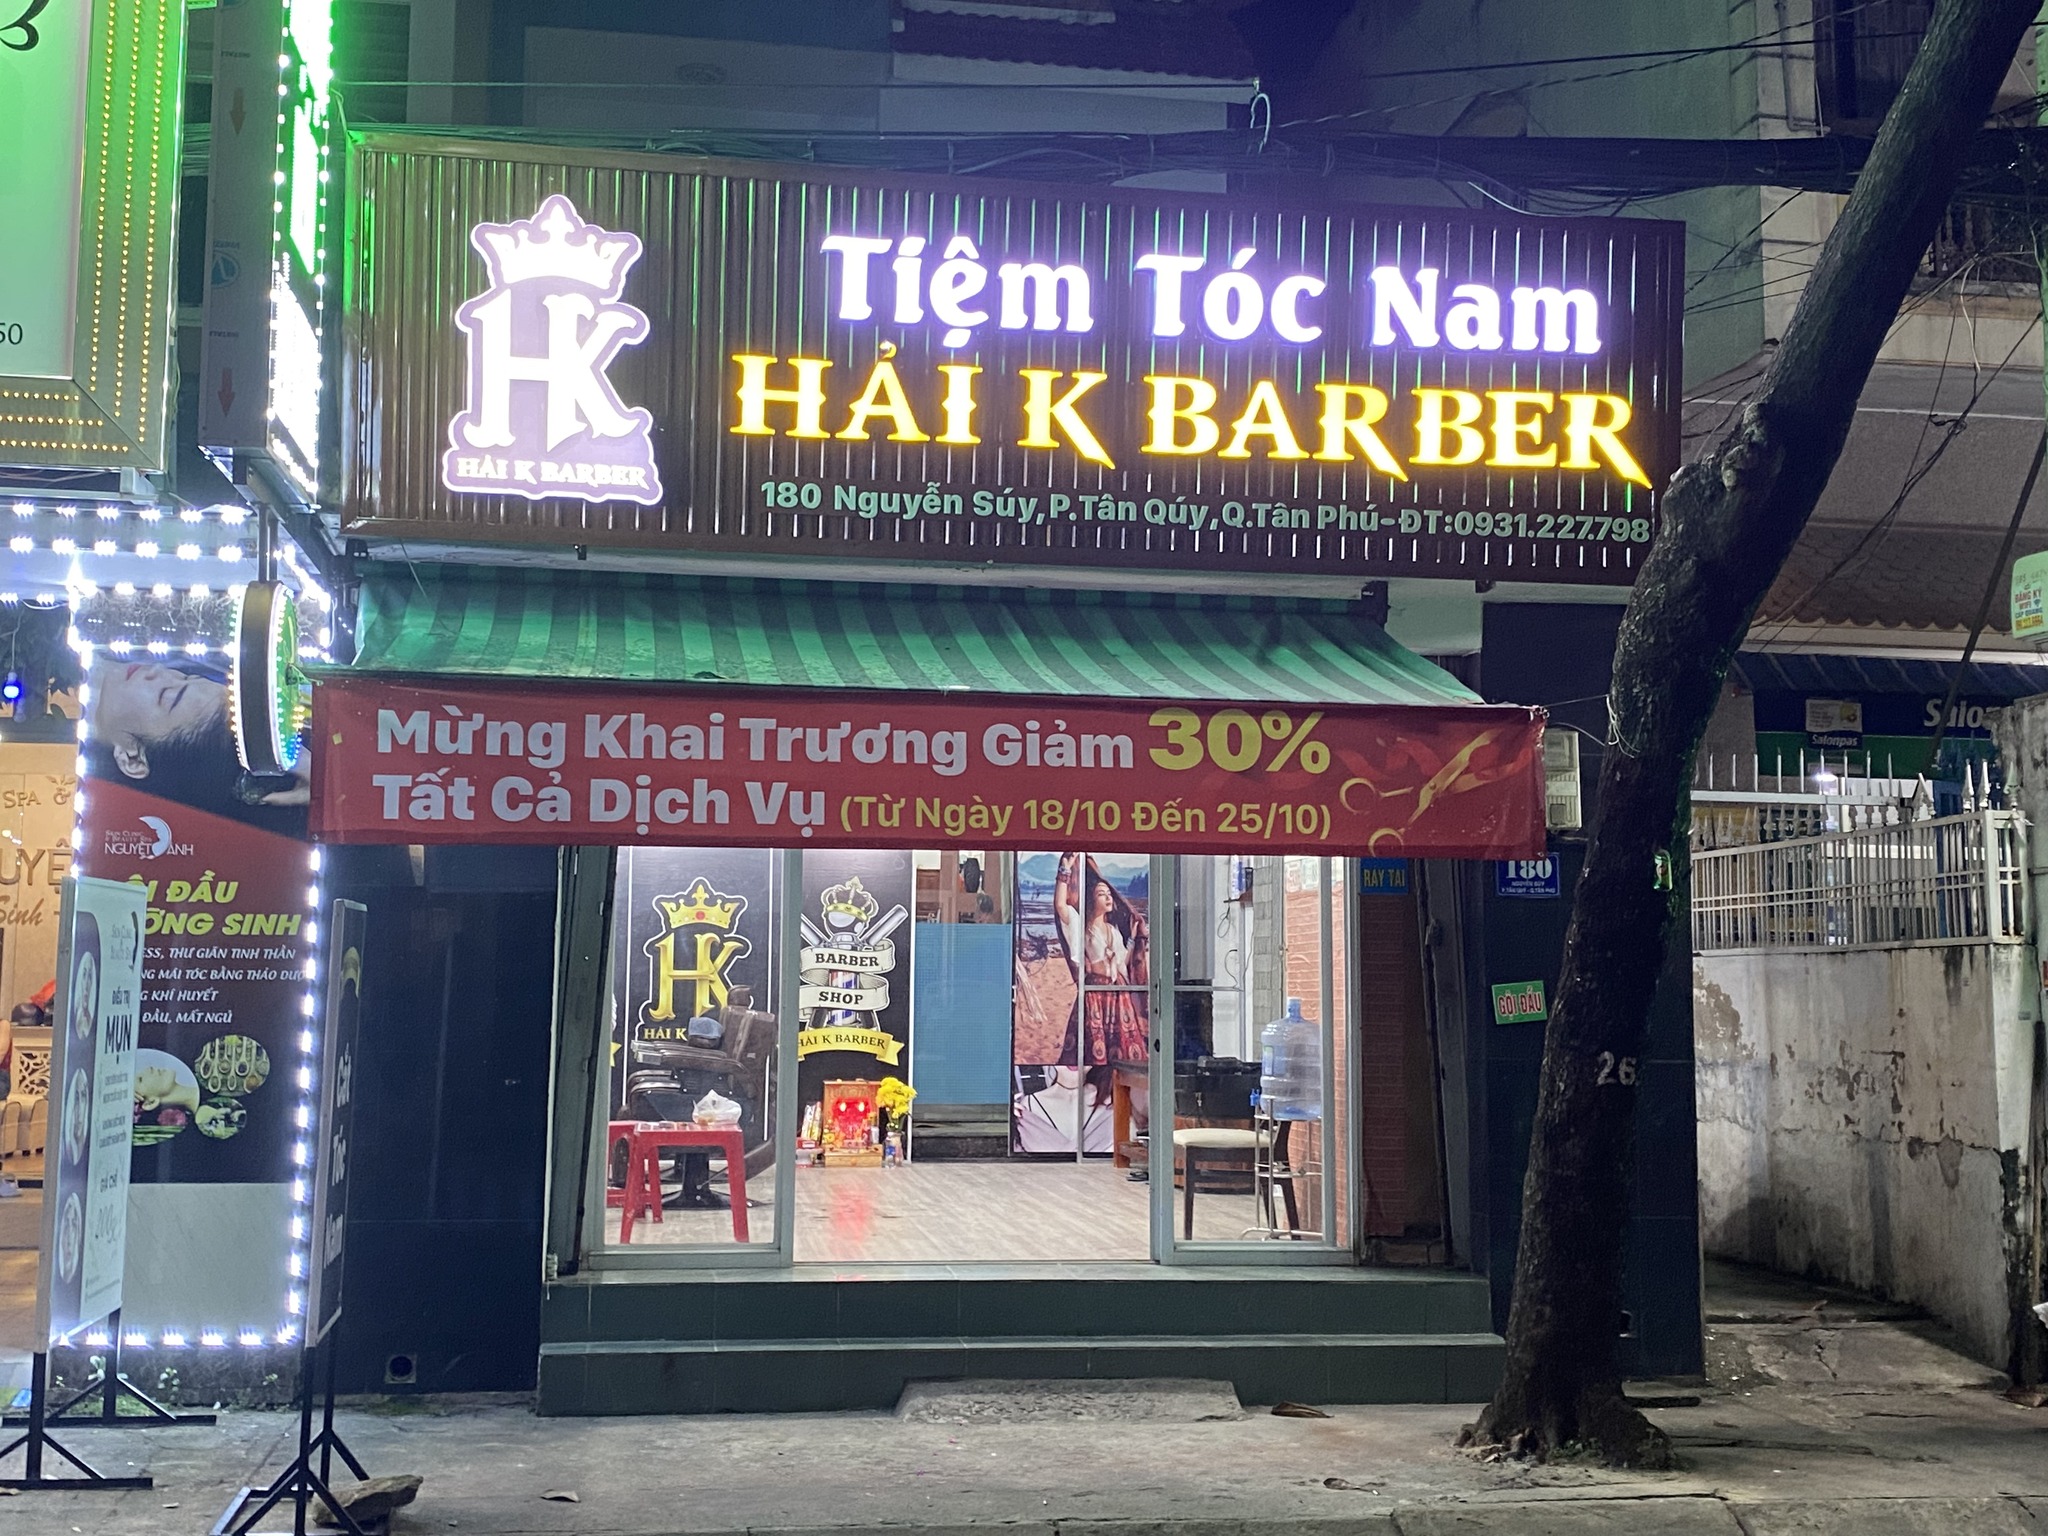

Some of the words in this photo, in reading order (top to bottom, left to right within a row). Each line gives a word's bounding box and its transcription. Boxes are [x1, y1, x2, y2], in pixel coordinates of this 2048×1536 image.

[820, 236, 1094, 349] Tiệm
[1134, 248, 1326, 343] Tóc
[1368, 266, 1600, 354] Nam
[463, 288, 640, 452] HK
[730, 341, 983, 445] HẢI
[1017, 369, 1116, 470] K
[1140, 375, 1653, 489] BARBER
[514, 460, 538, 484] K
[540, 461, 650, 490] BARBER
[761, 482, 822, 510] 180
[834, 481, 963, 519] Nguyễn
[377, 705, 566, 769] Mừng
[584, 713, 724, 760] Khai
[739, 716, 967, 776] Trương
[982, 719, 1134, 769] Giảm
[1148, 706, 1332, 775] 30%
[1811, 734, 1858, 748] Salonpas
[3, 790, 41, 809] SPA
[372, 768, 475, 821] Tất
[491, 771, 571, 822] Cả
[589, 774, 729, 836] Dịch
[744, 781, 826, 838] Vụ
[840, 794, 904, 833] (Từ
[915, 797, 1013, 837] Ngày
[1024, 799, 1120, 836] 18/10
[1131, 797, 1206, 834] Đến
[1217, 802, 1332, 840] 25/10)
[1388, 869, 1405, 887] TAI
[1506, 857, 1553, 879] 180
[166, 869, 239, 903] ĐẦU
[222, 913, 302, 936] SINH
[169, 947, 195, 960] THƯ
[196, 946, 227, 960] GIÃN
[231, 948, 259, 960] TINH
[263, 944, 296, 960] THẦN
[815, 953, 880, 967] BARBER
[158, 968, 182, 980] MÁI
[186, 968, 208, 980] TÓC
[649, 932, 744, 1021] HK
[151, 989, 176, 1001] KHÍ
[177, 987, 219, 1002] HUYẾT
[819, 991, 863, 1005] SHOP
[1498, 990, 1518, 1020] GỘI
[105, 1013, 132, 1064] MỤN
[675, 1028, 688, 1041] K
[822, 1034, 832, 1044] K
[835, 1034, 885, 1050] BARBER
[1597, 1051, 1636, 1086] 26
